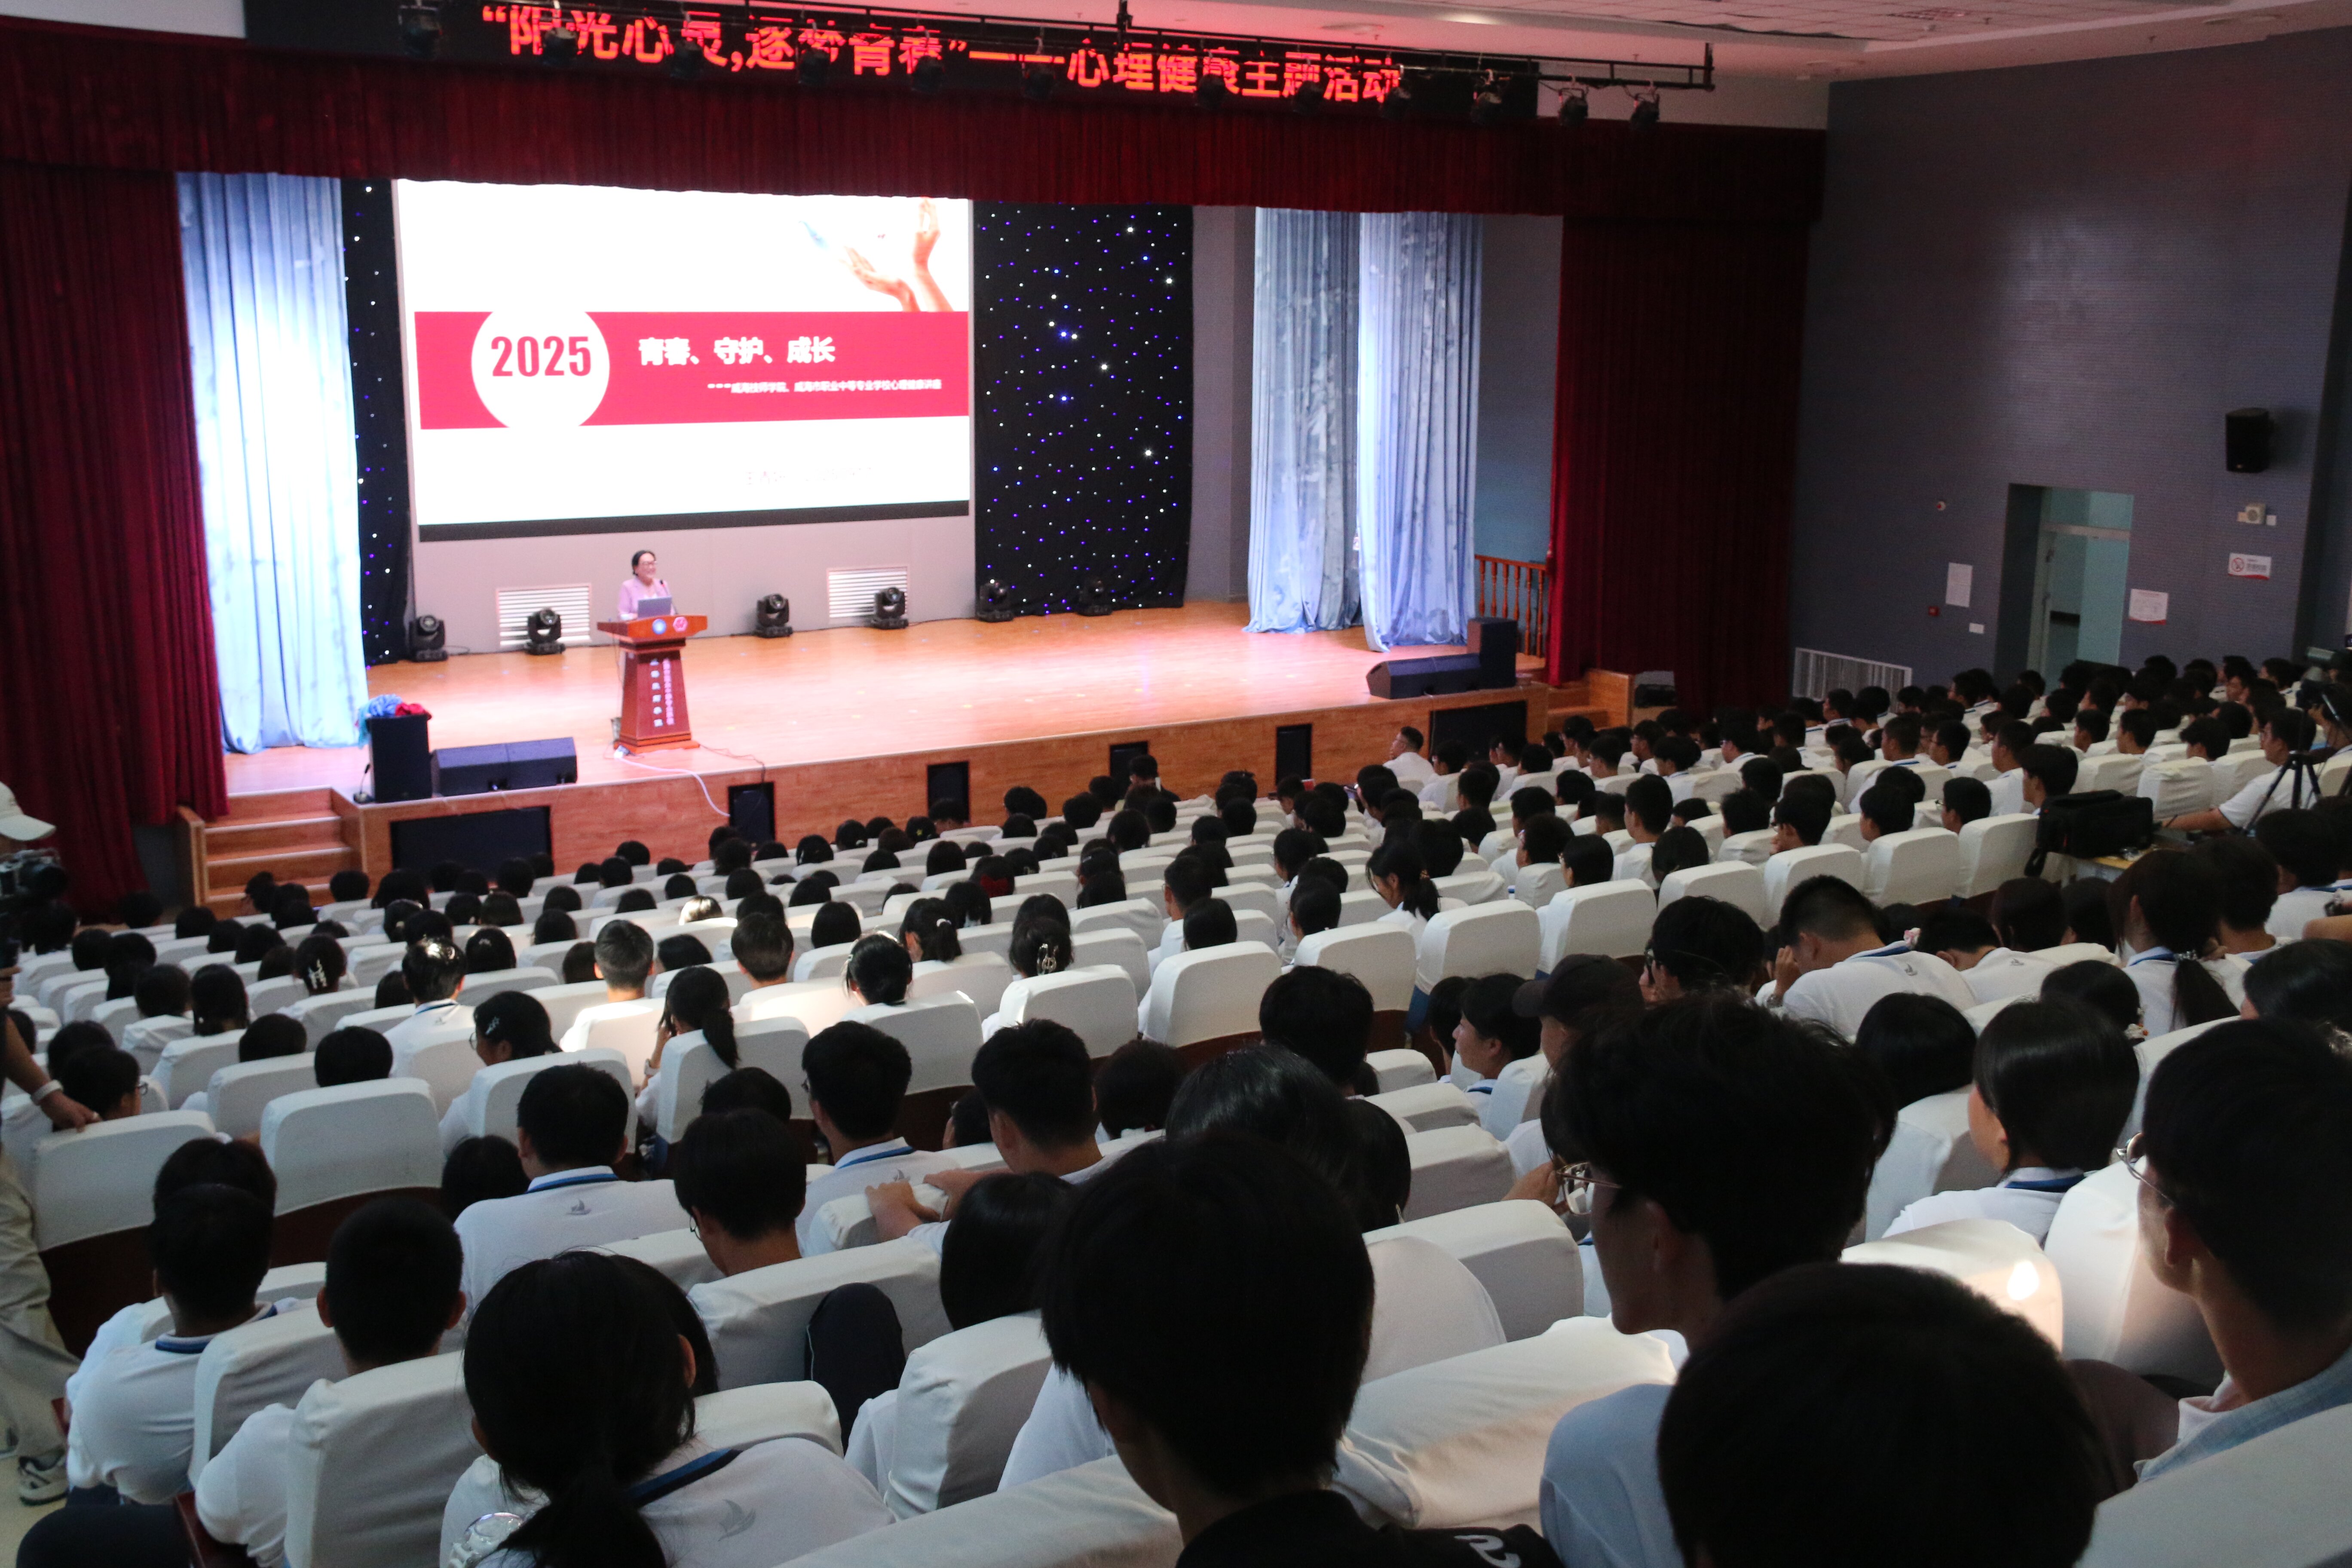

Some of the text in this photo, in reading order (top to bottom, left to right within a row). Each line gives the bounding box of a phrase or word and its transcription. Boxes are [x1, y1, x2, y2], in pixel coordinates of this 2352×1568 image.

[491, 336, 591, 377] 2025
[639, 336, 836, 365] 青春、守护、成长
